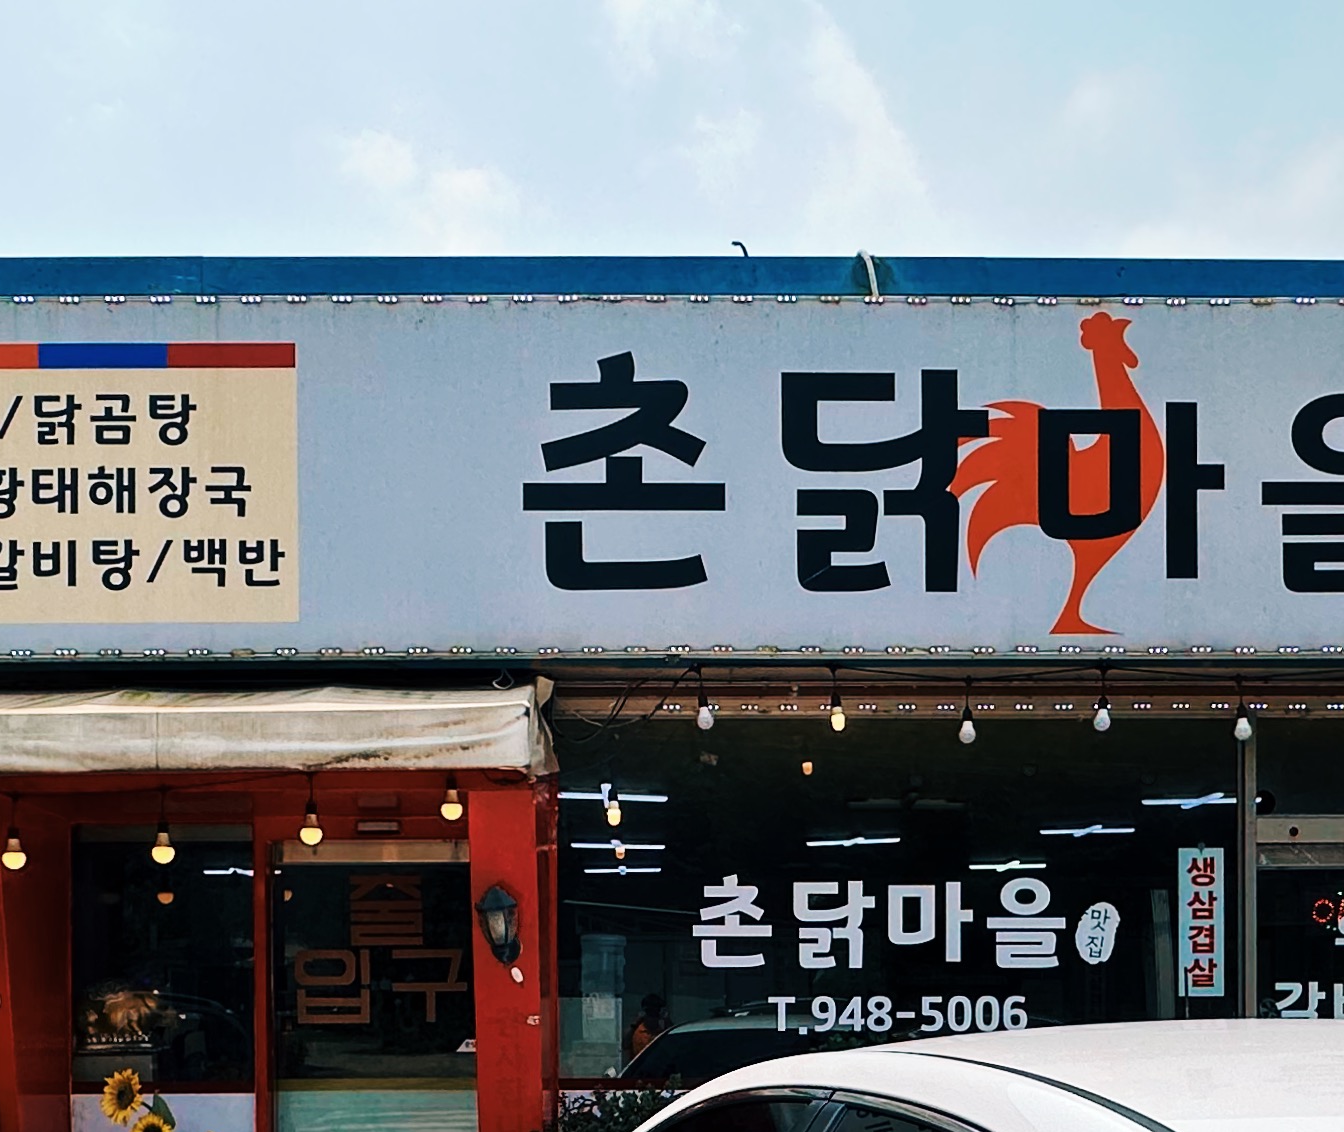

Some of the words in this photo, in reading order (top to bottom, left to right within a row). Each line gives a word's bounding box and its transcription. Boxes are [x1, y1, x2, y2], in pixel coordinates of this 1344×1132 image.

[692, 873, 1067, 970] 촌닭마을
[1084, 906, 1113, 960] 맛집
[1186, 856, 1218, 988] 생삼겹살
[294, 948, 468, 1025] 입구
[767, 995, 1029, 1036] T.948-5006
